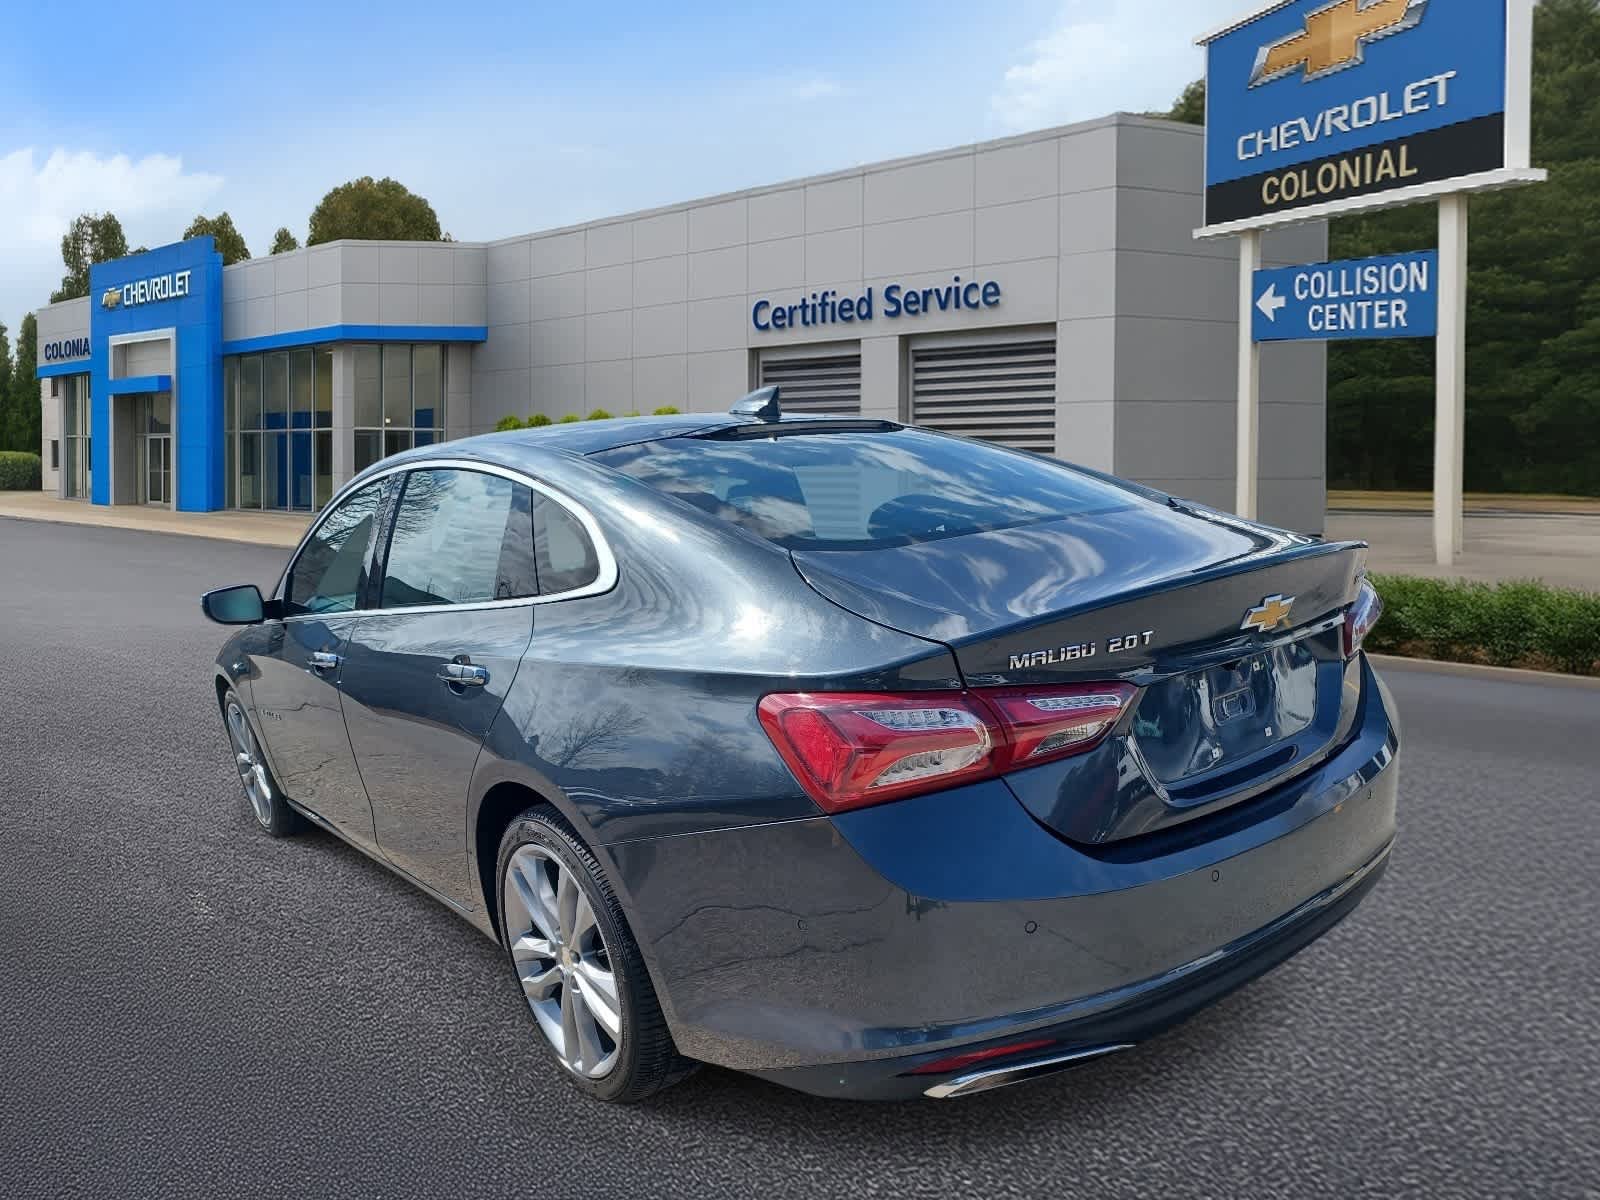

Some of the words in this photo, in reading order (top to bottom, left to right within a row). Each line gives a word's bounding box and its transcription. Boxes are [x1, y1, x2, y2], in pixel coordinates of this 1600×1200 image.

[1237, 70, 1457, 160] CHEVROLET
[1261, 144, 1418, 205] COLONIAL
[123, 270, 192, 306] CHEVROLET
[1294, 260, 1429, 301] COLLISION
[752, 287, 873, 331] Certified
[884, 276, 1001, 318] Service
[1308, 299, 1408, 331] CENTER
[1009, 642, 1096, 670] MALIBU
